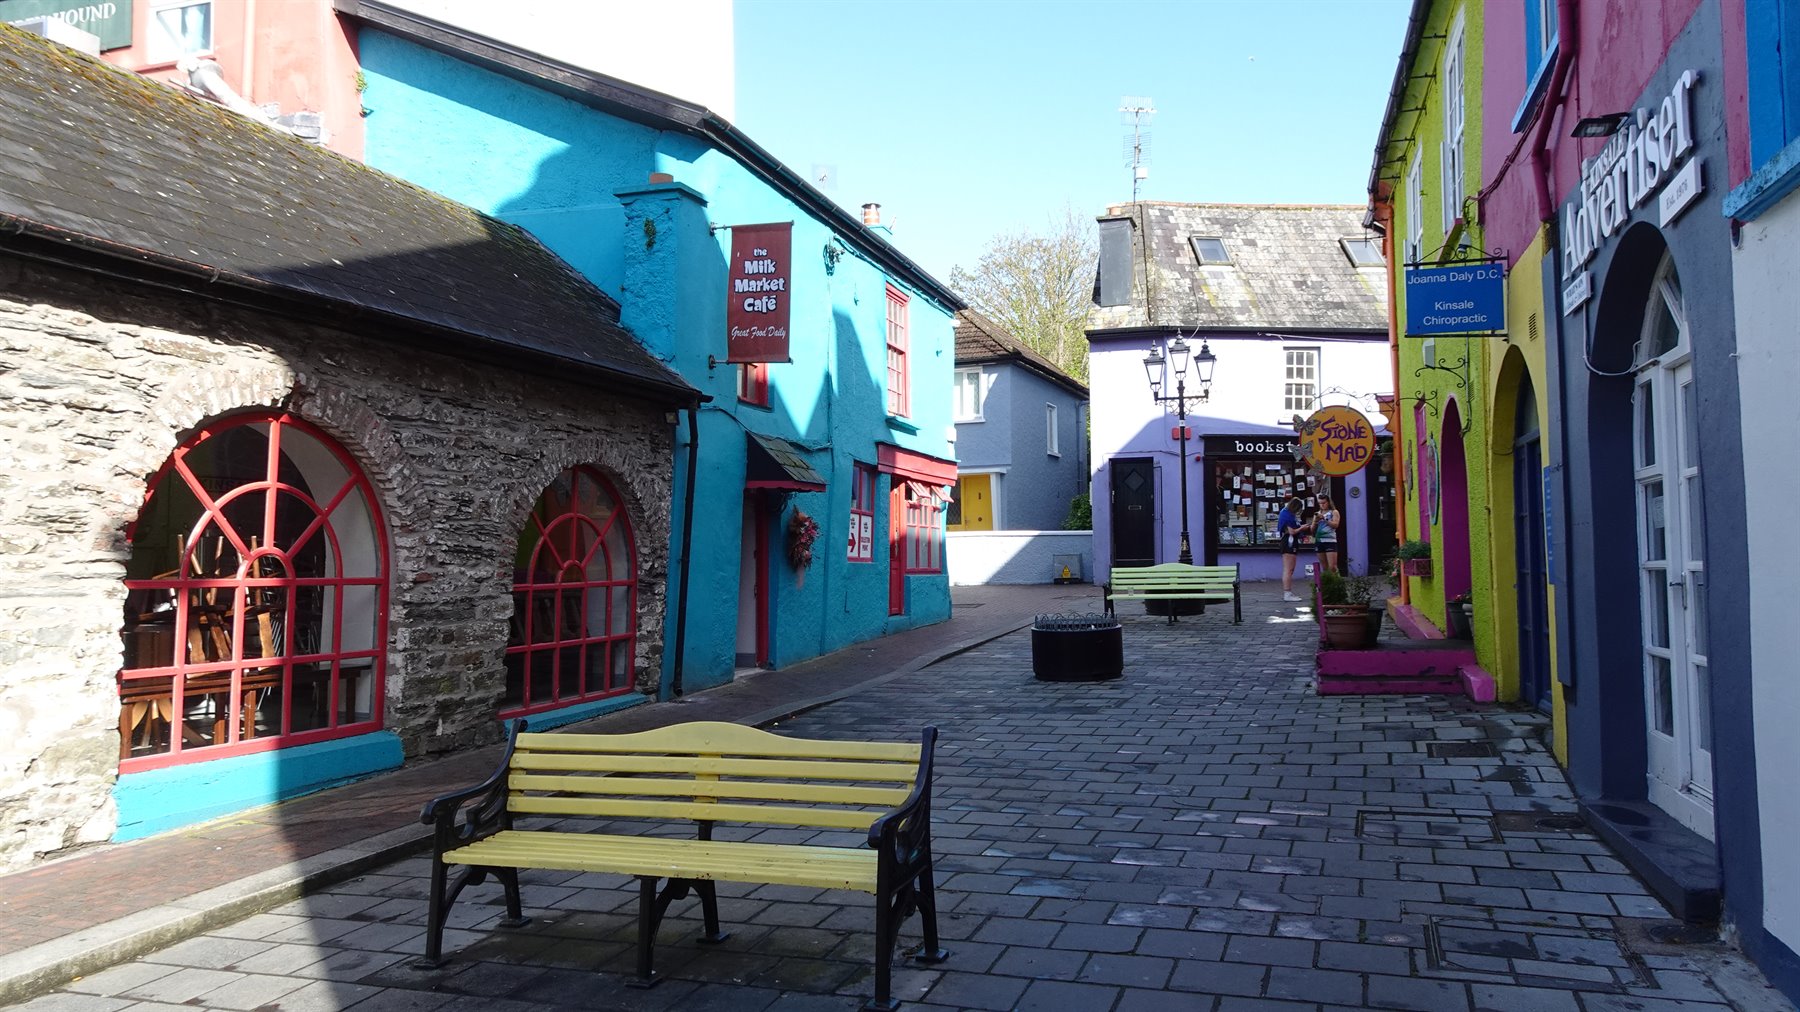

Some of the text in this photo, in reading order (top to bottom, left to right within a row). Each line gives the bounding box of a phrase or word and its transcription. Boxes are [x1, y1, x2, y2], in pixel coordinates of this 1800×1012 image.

[1562, 69, 1698, 282] Advertiser
[753, 247, 768, 257] the
[744, 259, 777, 275] Milk
[734, 277, 785, 293] Market
[1407, 269, 1501, 285] Joanna Daly D.C.
[743, 294, 777, 313] Café
[1434, 299, 1474, 311] Kinsale
[1422, 313, 1488, 326] Chiropractic
[731, 325, 787, 340] Great Food Daily
[1318, 415, 1368, 447] STONE
[1235, 440, 1300, 453] bookst
[1325, 442, 1368, 463] MAD
